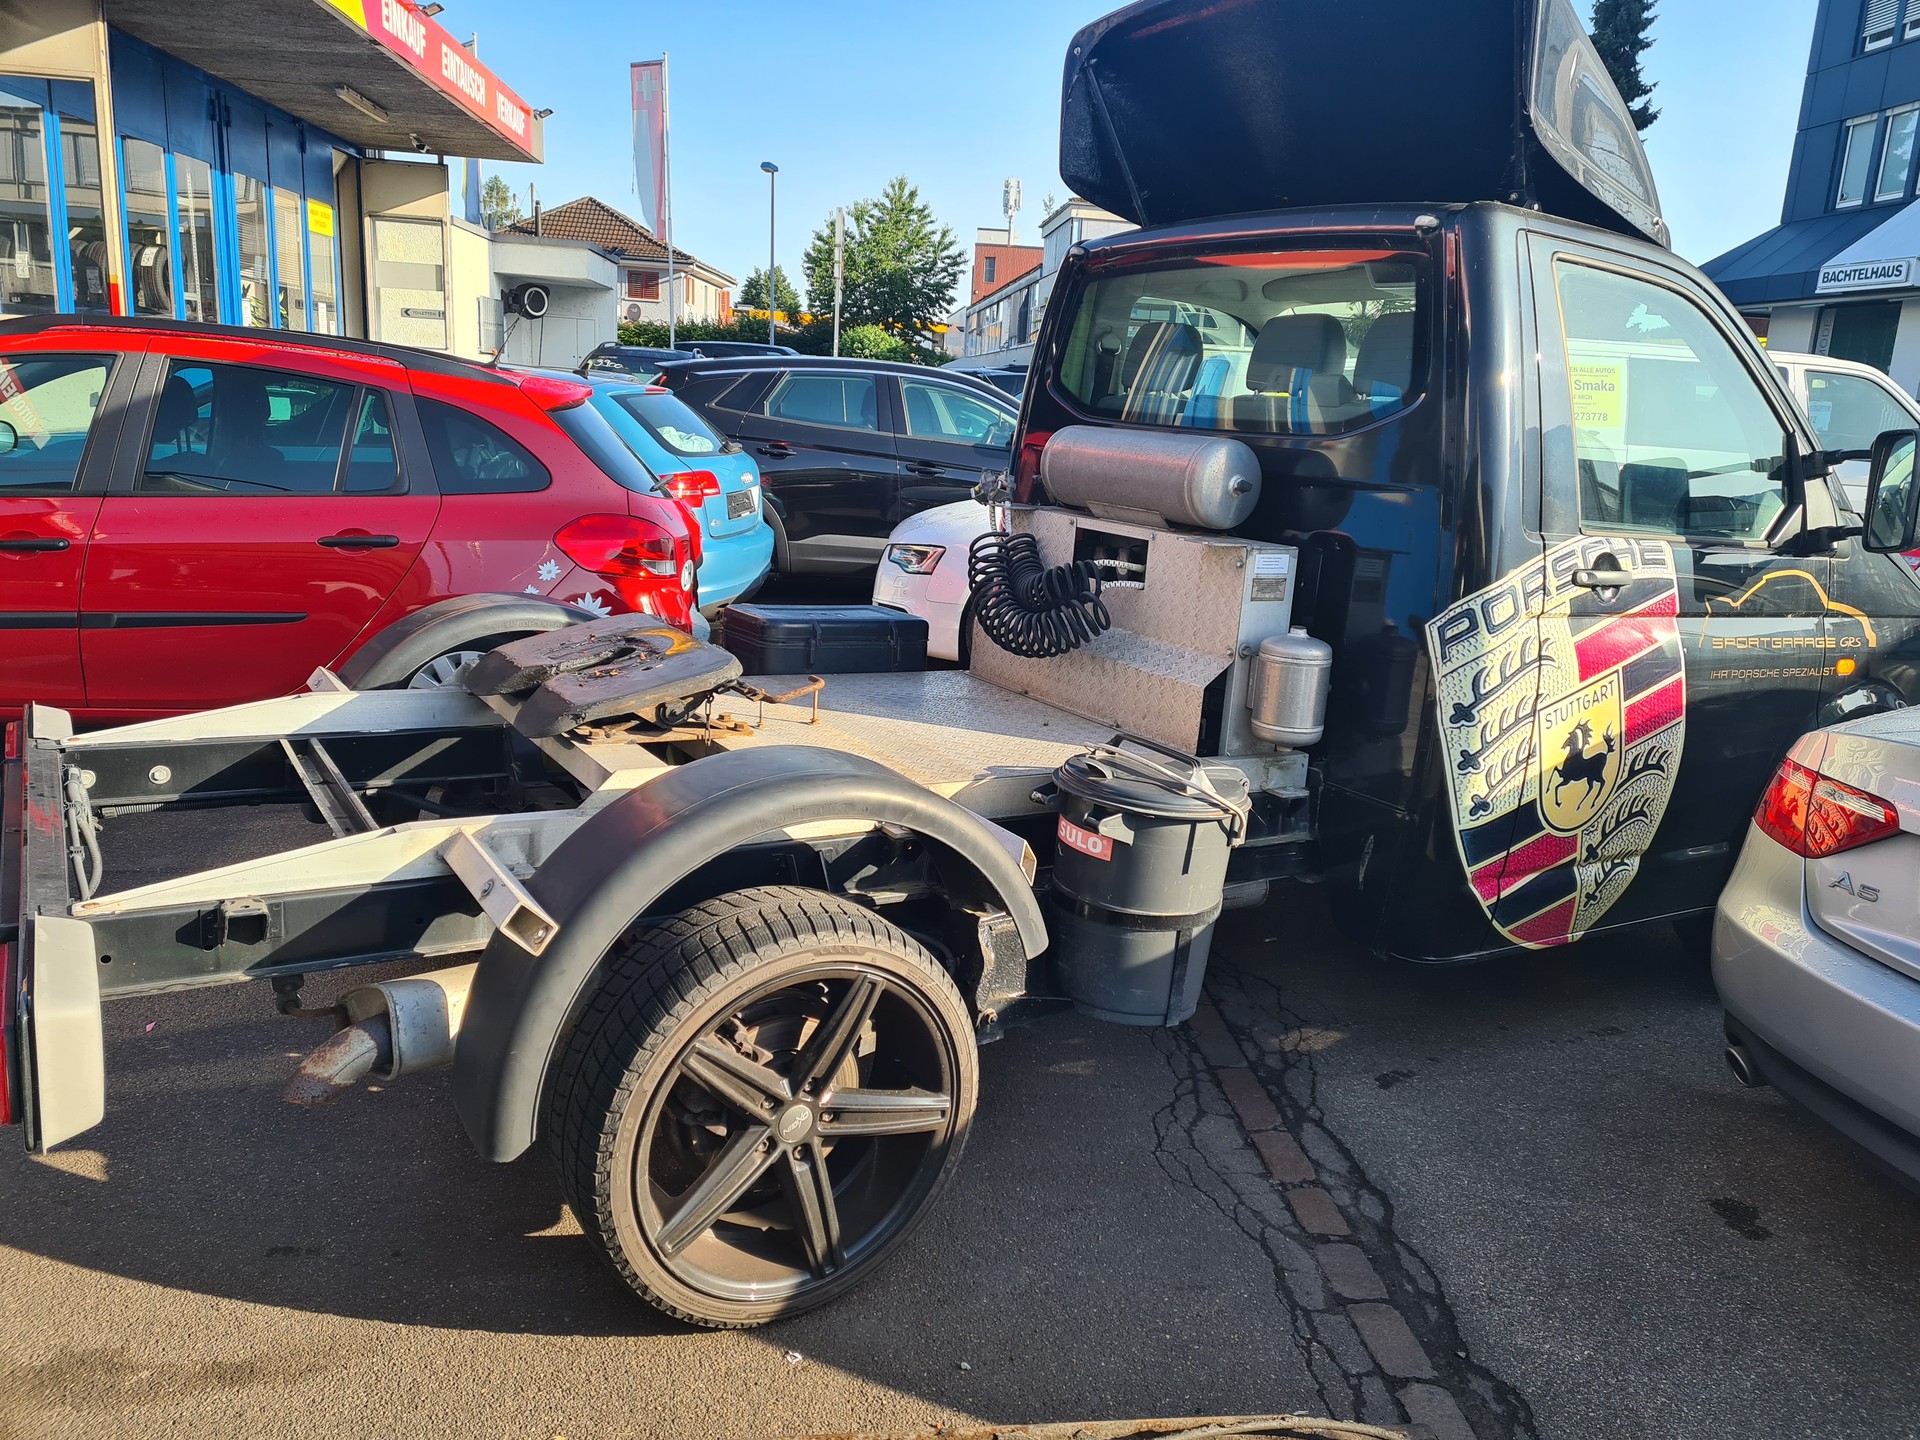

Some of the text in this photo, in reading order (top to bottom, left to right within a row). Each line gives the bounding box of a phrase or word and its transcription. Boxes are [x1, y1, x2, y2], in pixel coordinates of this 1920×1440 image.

[381, 0, 525, 137] EINKAUF EINTAUSCH VERKAUF
[1822, 264, 1903, 283] BACHTELHAUS
[1574, 379, 1615, 391] Smaka
[1437, 537, 1668, 664] PORSCHE
[1712, 637, 1836, 649] SPORTGARAGE
[1711, 667, 1836, 680] IHR PORSCHE SPEZIALIST
[1545, 680, 1616, 730] STUTTGART
[1060, 820, 1103, 854] SULO
[1828, 870, 1880, 902] A5
